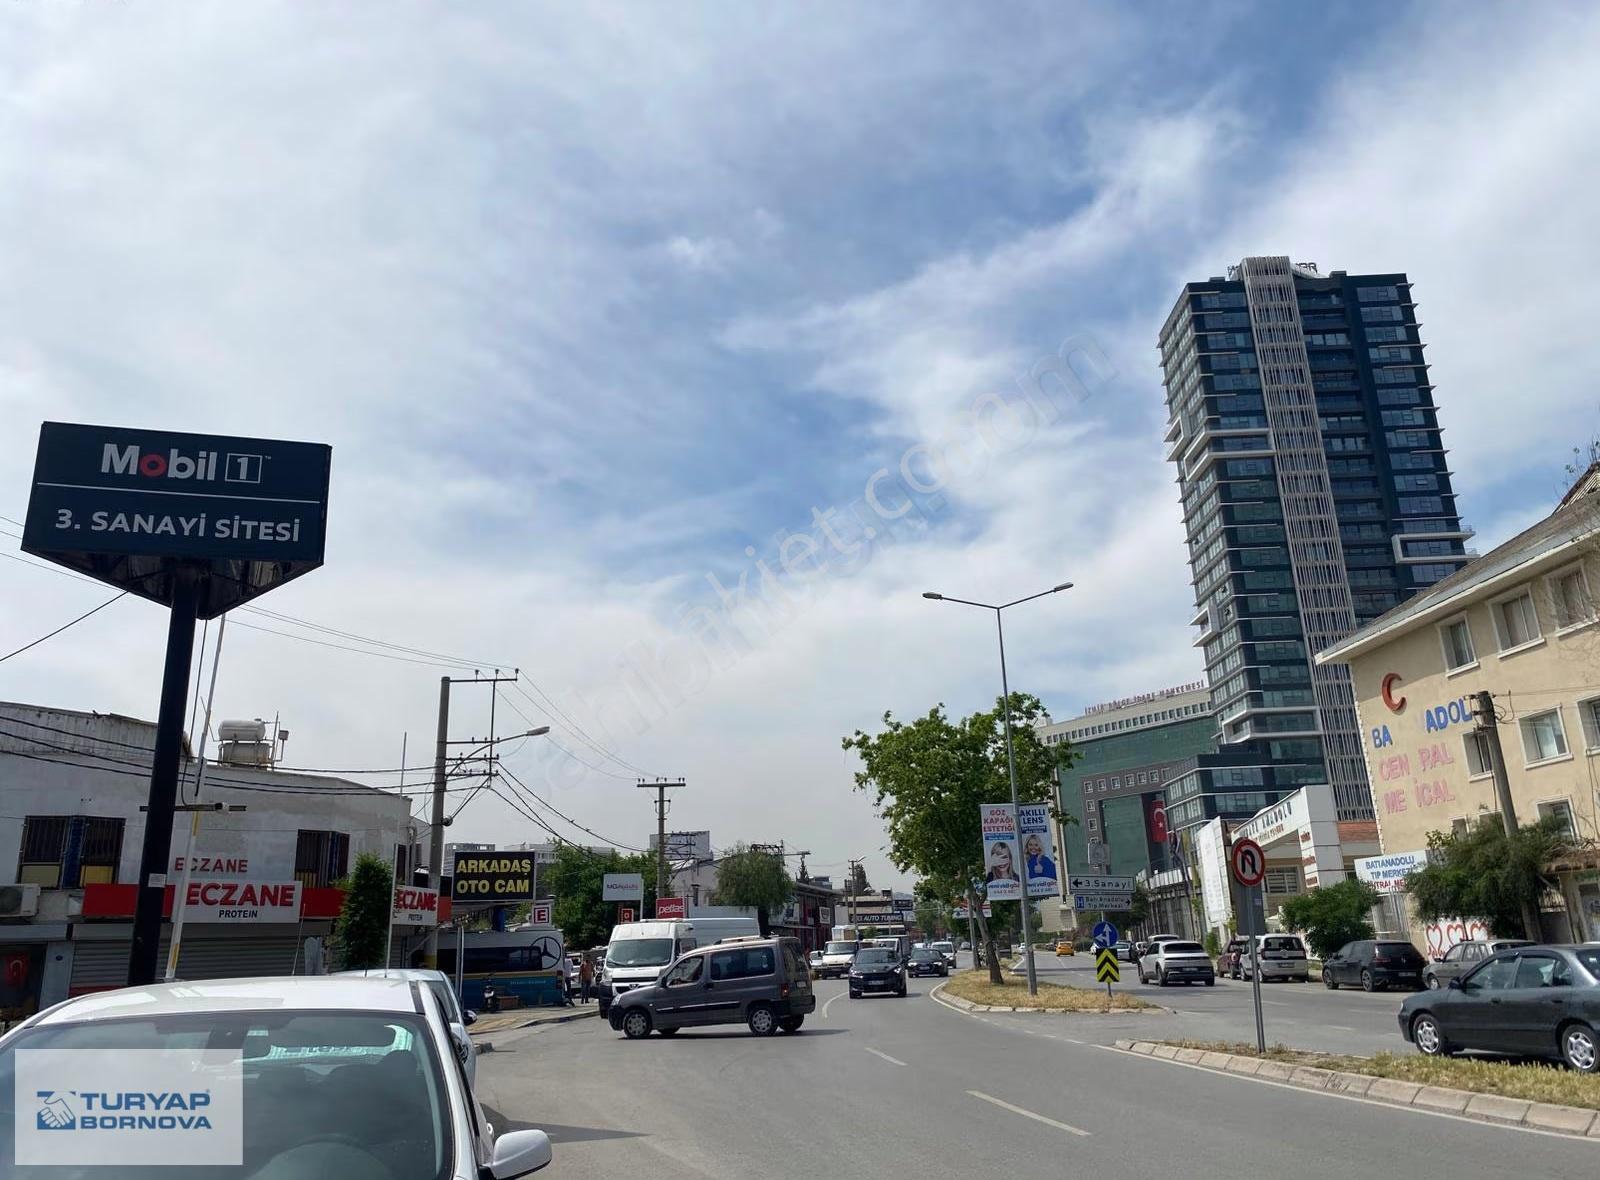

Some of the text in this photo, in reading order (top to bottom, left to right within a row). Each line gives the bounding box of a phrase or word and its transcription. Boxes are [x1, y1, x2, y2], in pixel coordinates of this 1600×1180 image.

[100, 443, 217, 481] Mobil
[55, 508, 300, 542] 3. SANAYİ SİTESİ
[1022, 816, 1044, 825] LENS
[455, 858, 531, 875] ARKADAŞ
[185, 882, 295, 908] ECZANE
[456, 879, 529, 894] OTO CAM
[399, 889, 437, 911] ECZANE
[536, 909, 547, 920] E
